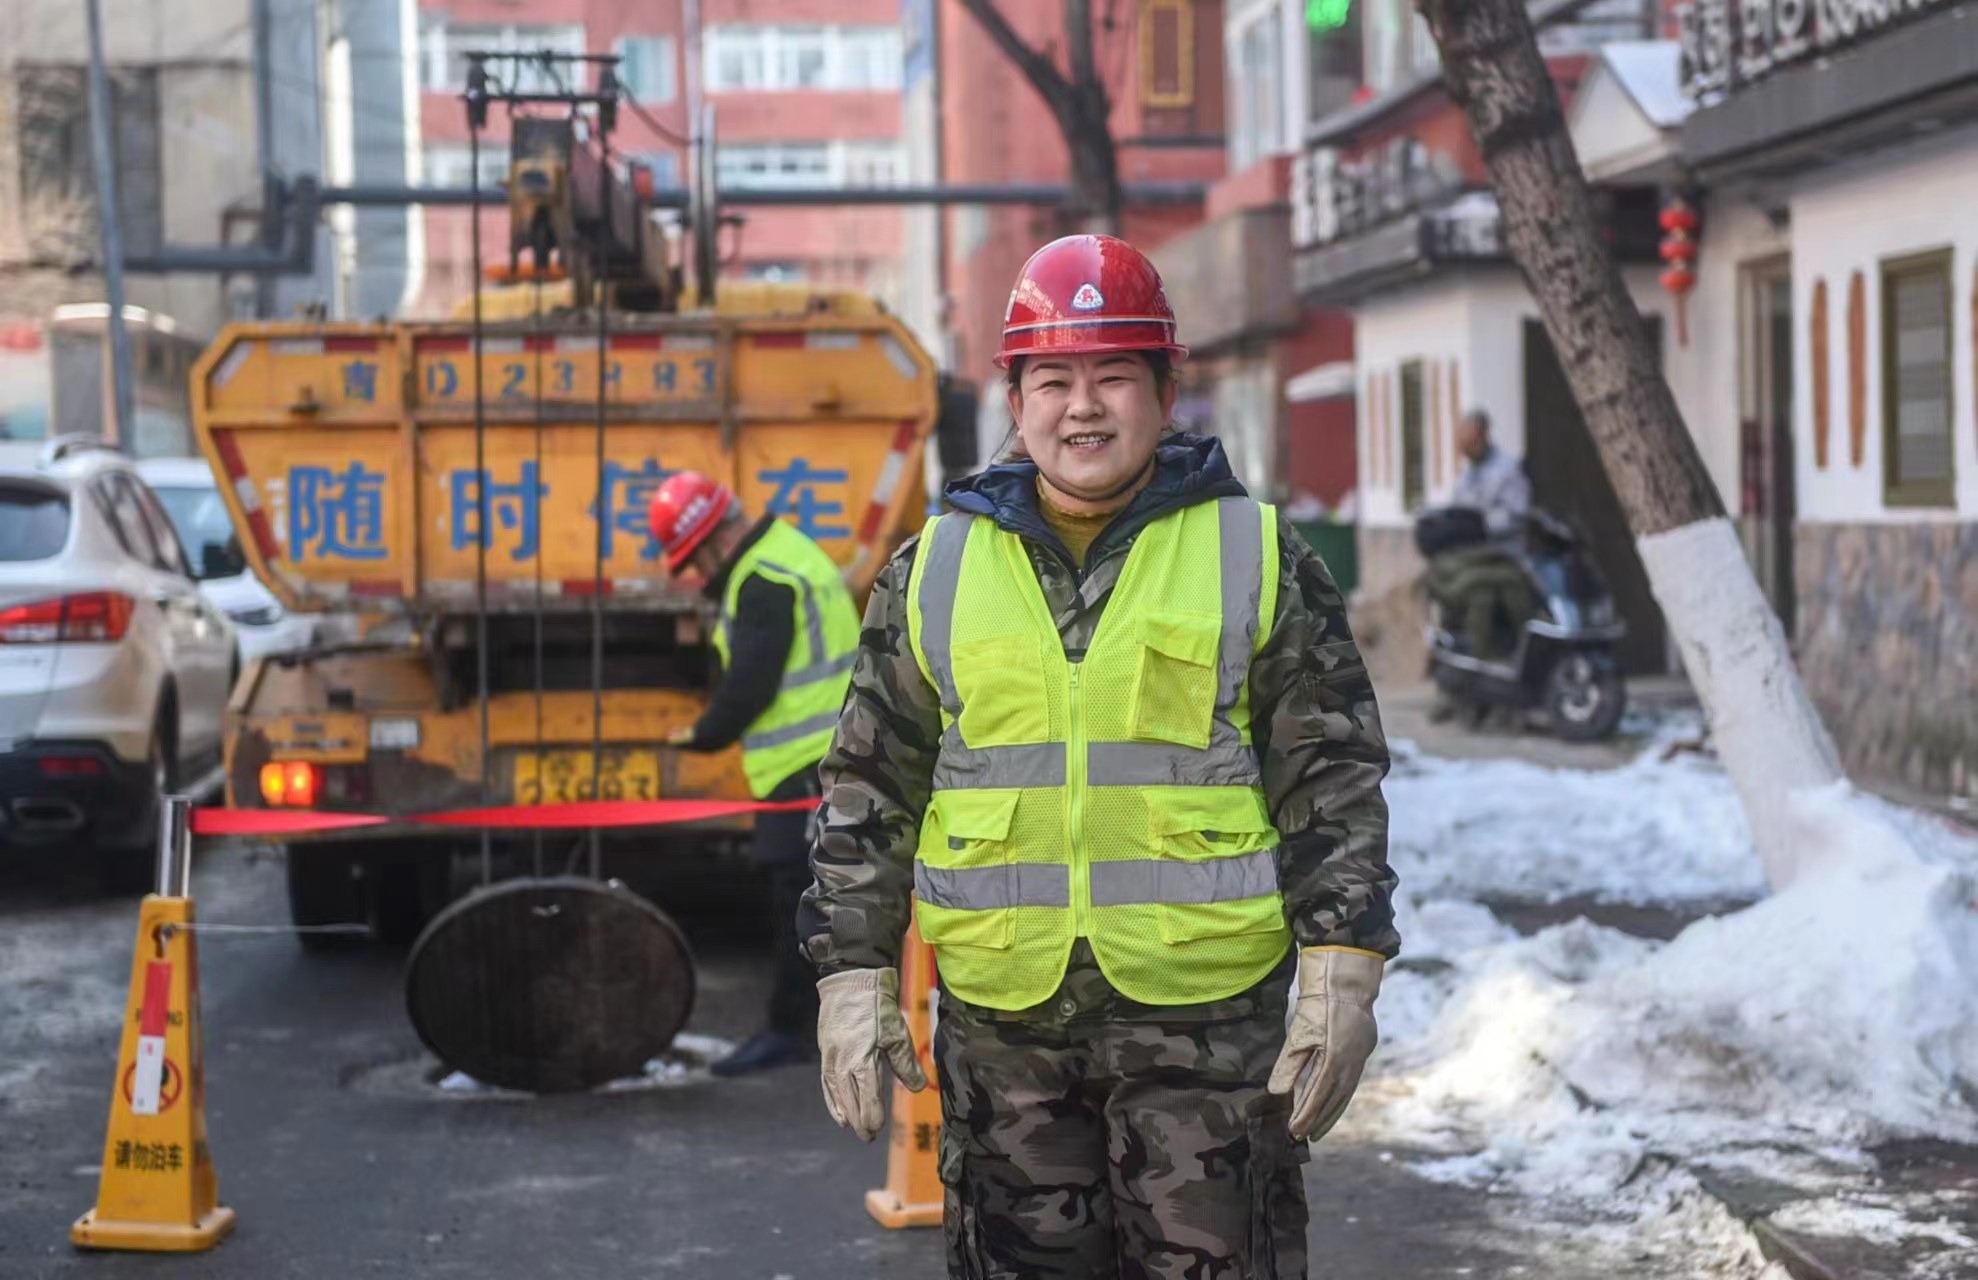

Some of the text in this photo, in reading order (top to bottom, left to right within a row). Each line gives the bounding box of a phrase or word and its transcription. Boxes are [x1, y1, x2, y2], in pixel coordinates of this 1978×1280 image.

[288, 459, 852, 562] 随时停车
[115, 1140, 184, 1171] 请勿泊车
